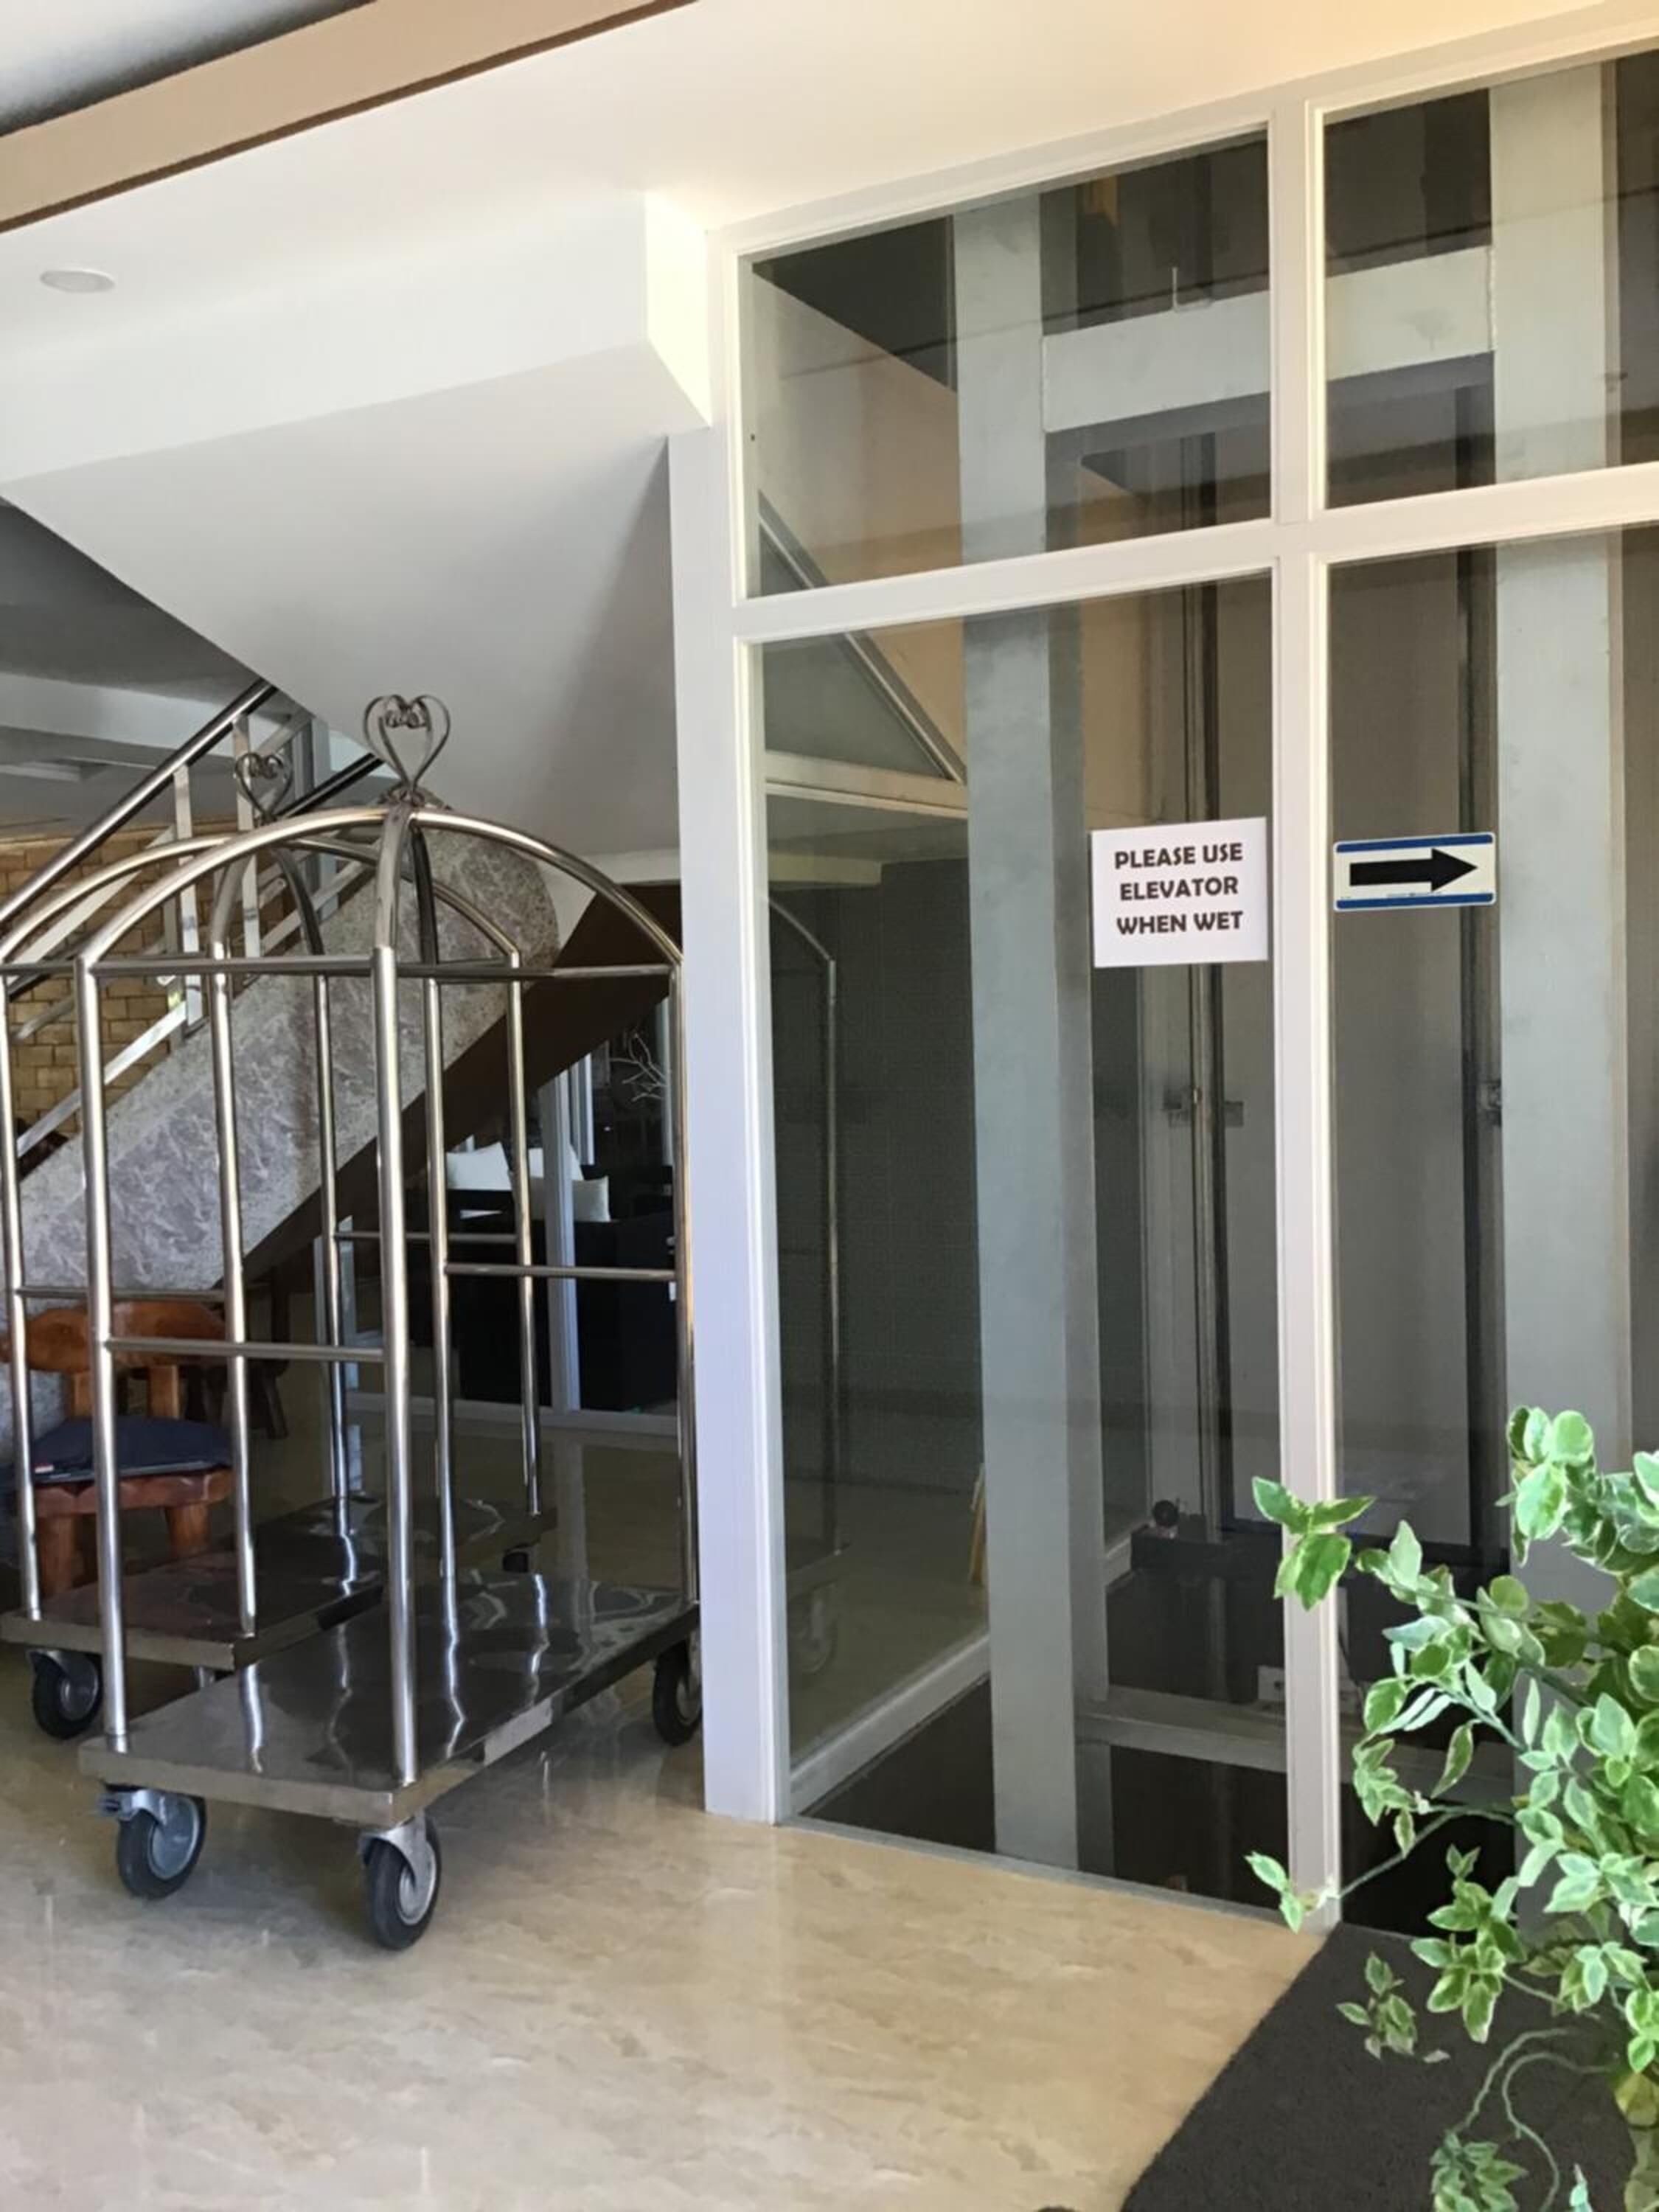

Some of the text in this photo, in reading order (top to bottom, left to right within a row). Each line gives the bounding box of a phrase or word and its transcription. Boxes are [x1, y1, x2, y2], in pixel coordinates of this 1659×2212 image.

[1115, 843, 1243, 869] PLEASE USE
[1120, 876, 1238, 901] ELEVATOR
[1116, 911, 1244, 935] WHEN WET
